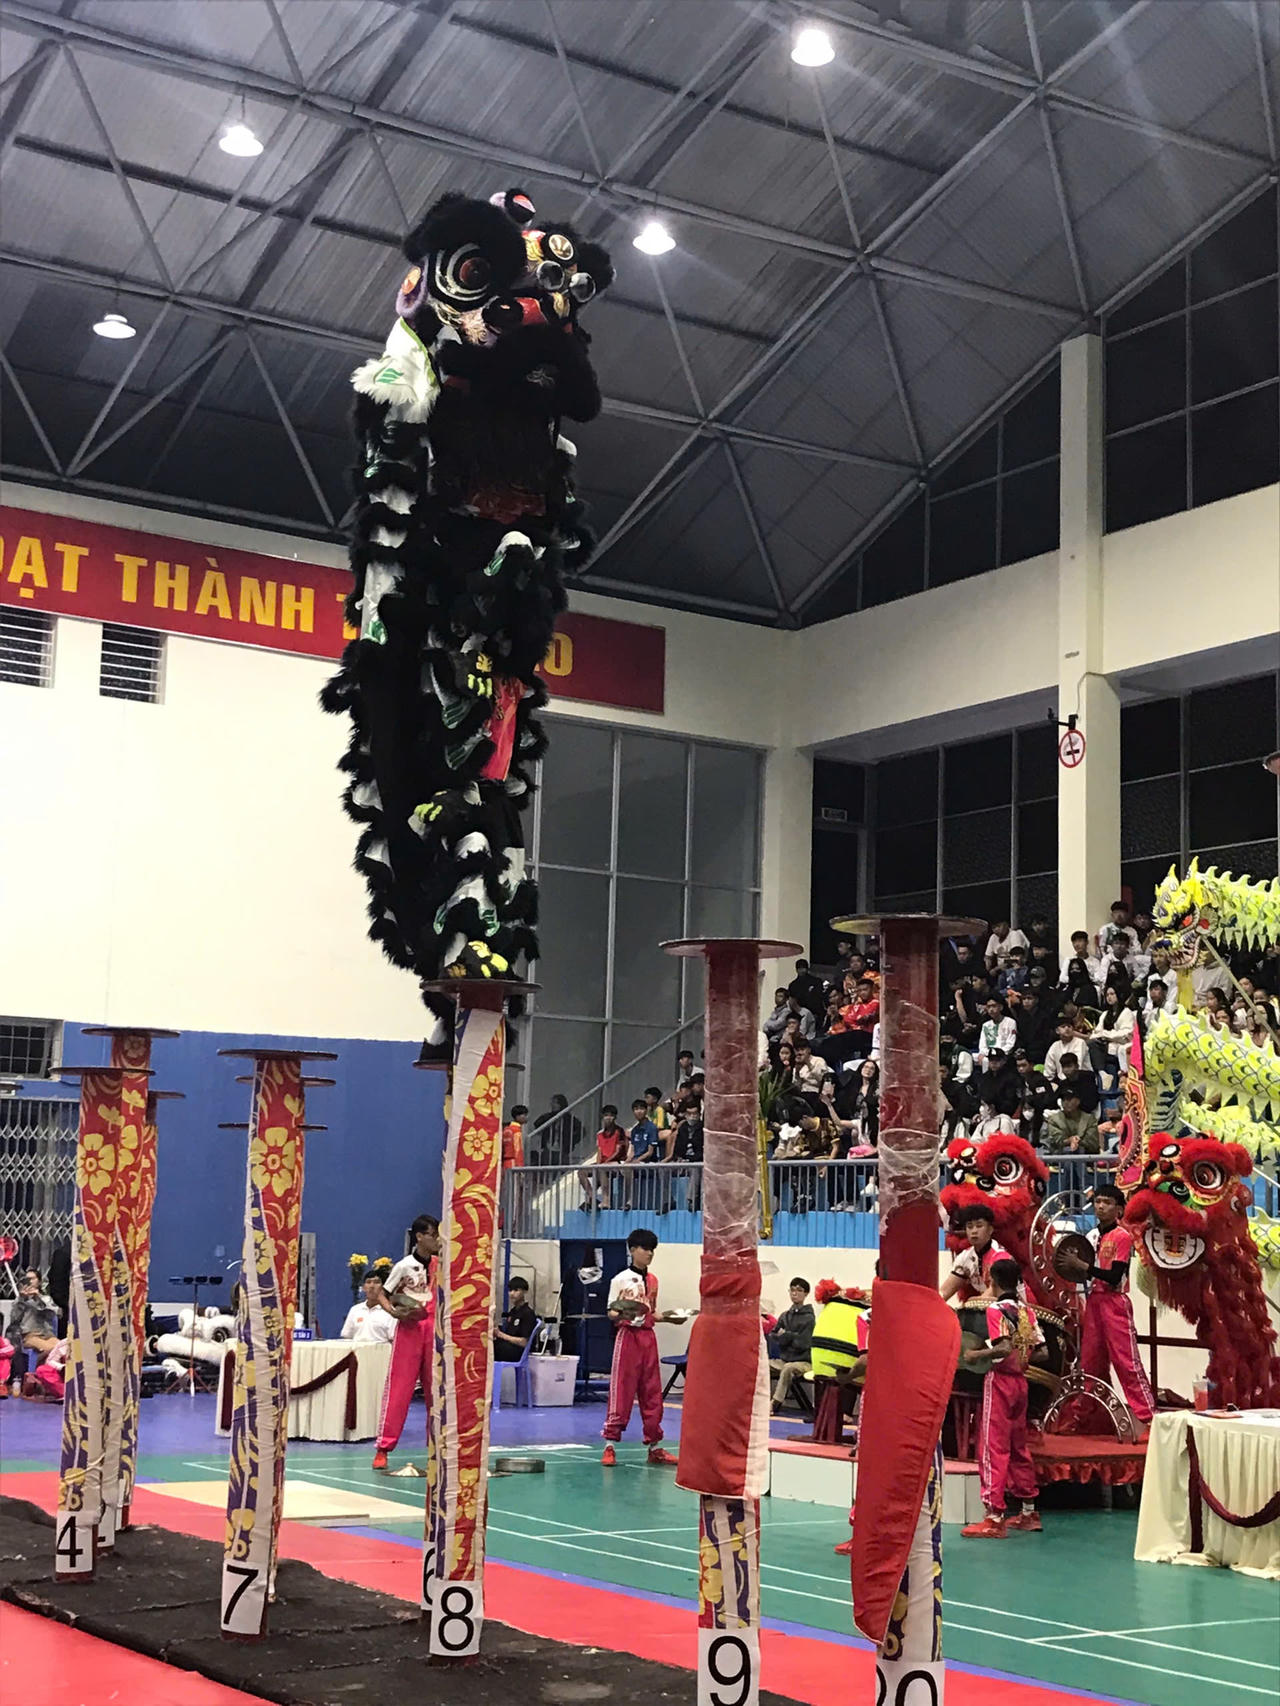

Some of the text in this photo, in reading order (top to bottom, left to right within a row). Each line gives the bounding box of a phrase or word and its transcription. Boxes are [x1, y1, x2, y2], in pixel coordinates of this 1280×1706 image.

[0, 536, 89, 599] ẠT
[114, 553, 315, 633] THÀNH
[57, 1516, 83, 1568] 4
[223, 1564, 259, 1625] 7
[438, 1586, 474, 1651] 8
[708, 1636, 751, 1706] 9
